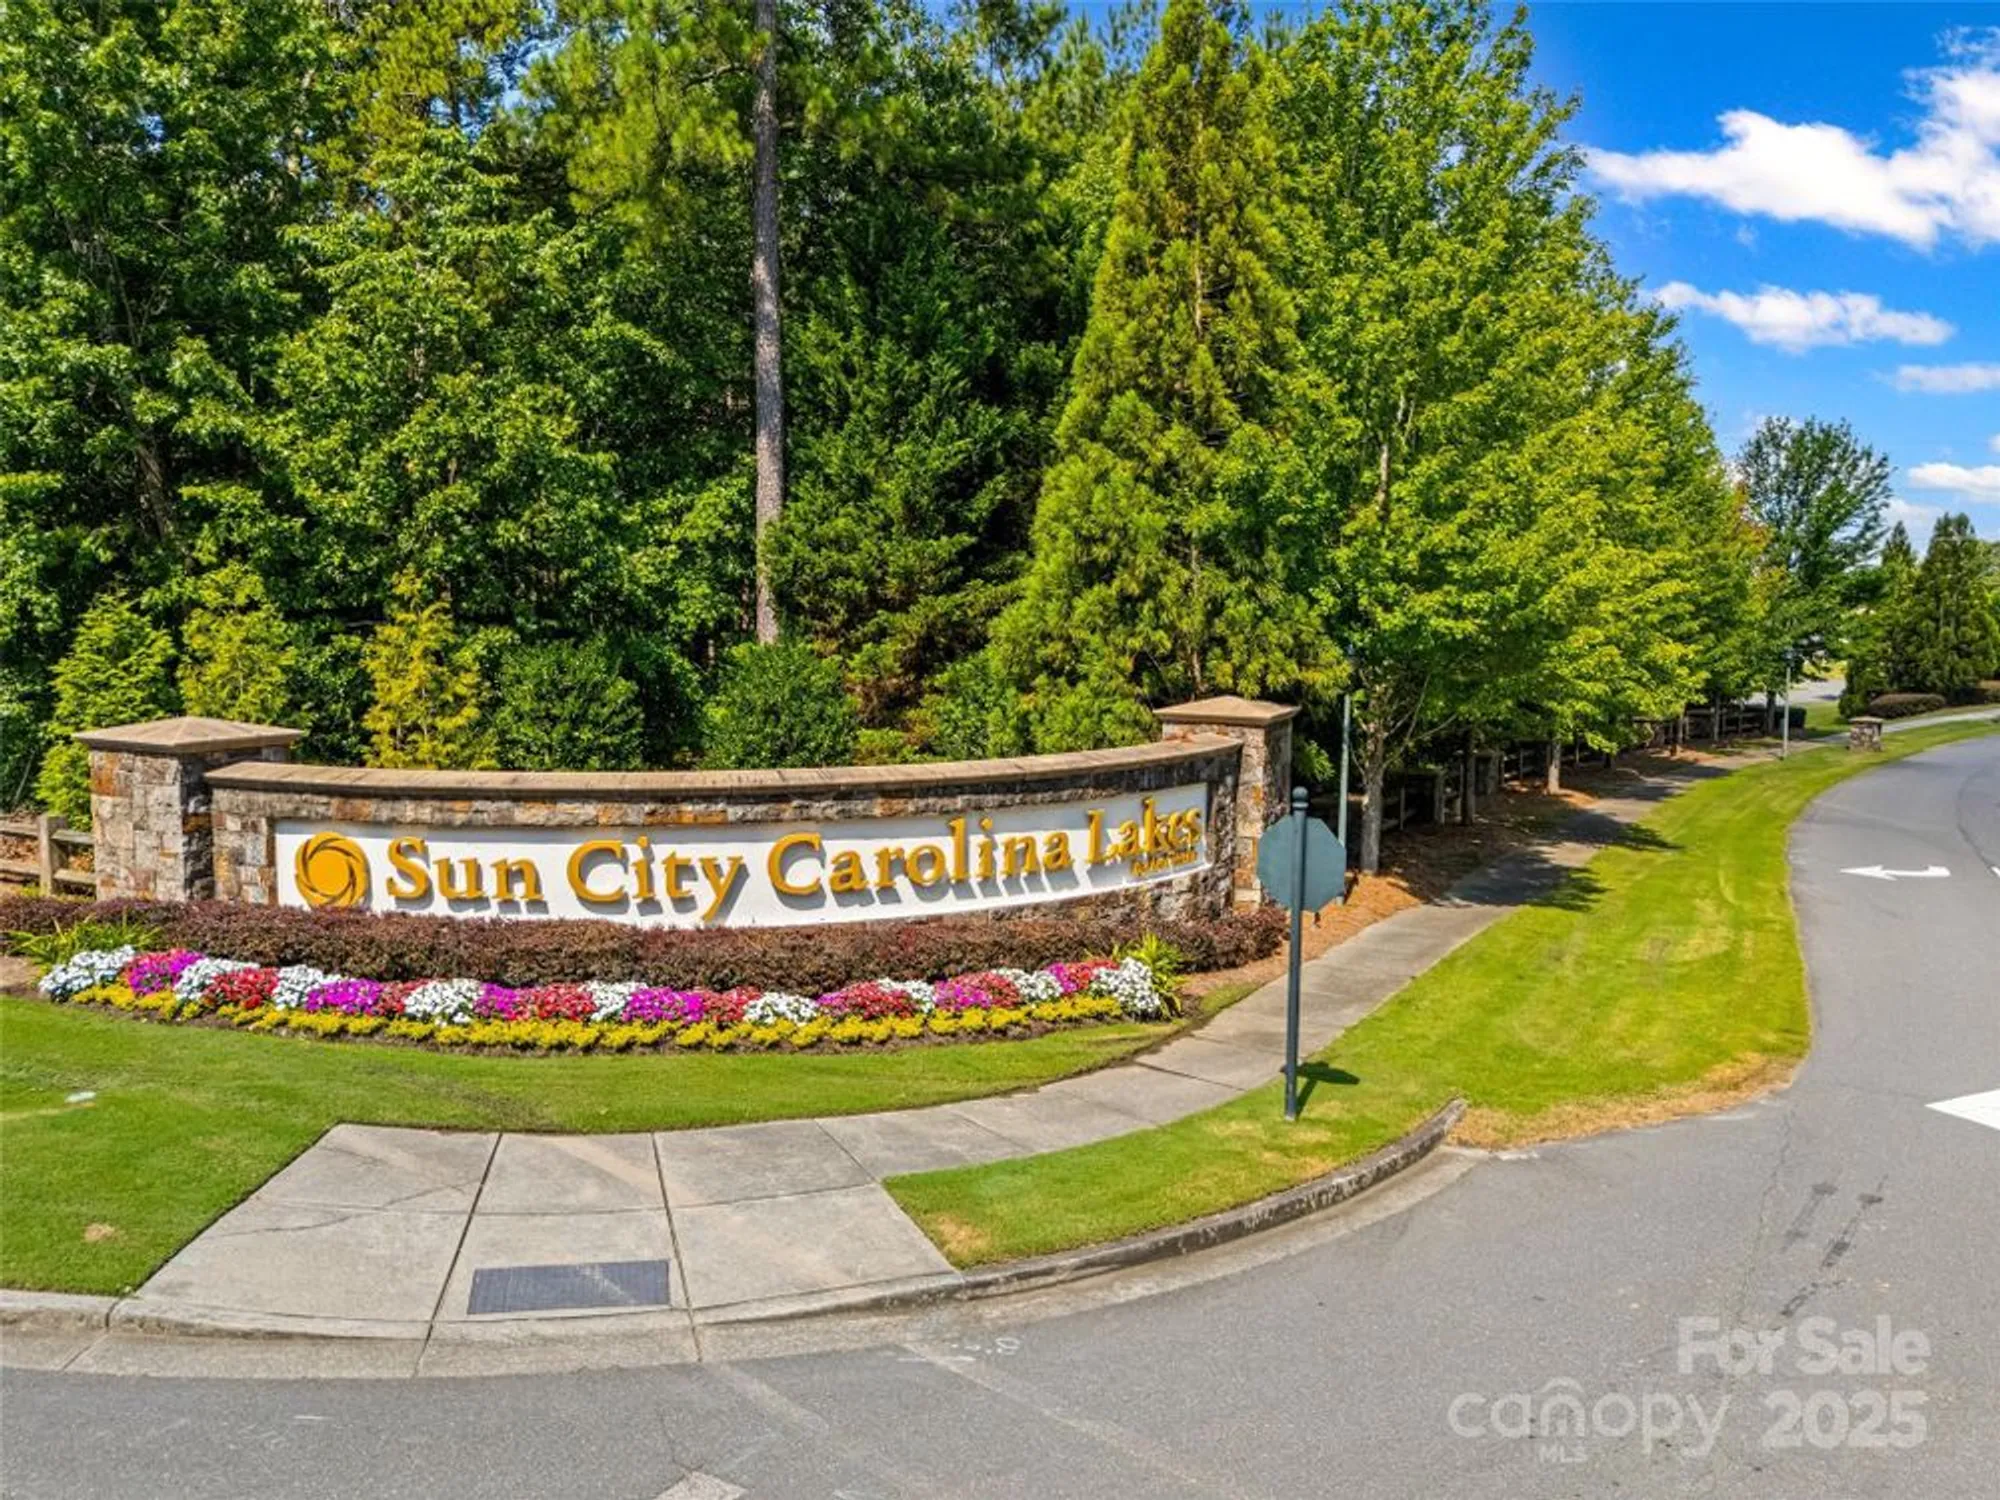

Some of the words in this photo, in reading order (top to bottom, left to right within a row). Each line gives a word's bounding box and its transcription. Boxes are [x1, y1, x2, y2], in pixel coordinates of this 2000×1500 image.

[385, 836, 544, 900] Sun
[566, 836, 743, 921] City
[767, 817, 1075, 896] Carolina
[1086, 796, 1202, 865] Lakes
